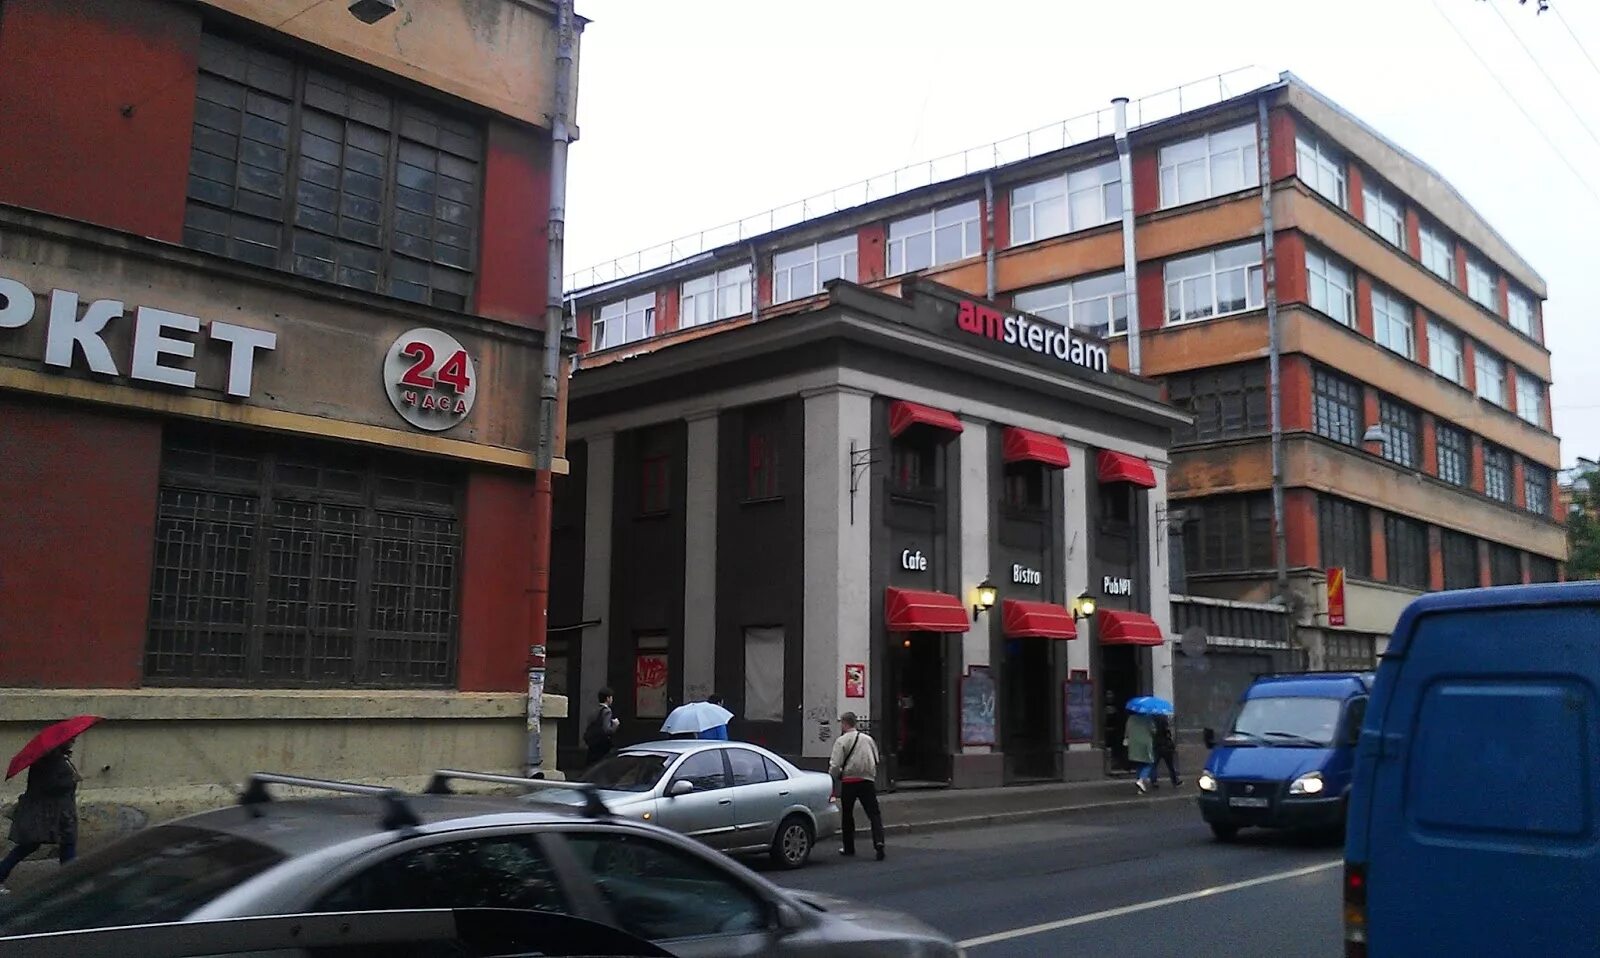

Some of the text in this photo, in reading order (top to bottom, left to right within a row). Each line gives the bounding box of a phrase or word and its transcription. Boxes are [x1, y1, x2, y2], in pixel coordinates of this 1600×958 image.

[958, 299, 1108, 374] amsterdam
[401, 341, 471, 394] 24
[404, 390, 468, 415] ЧАСА
[902, 549, 927, 571] Cafe
[1013, 564, 1040, 585] Bistro
